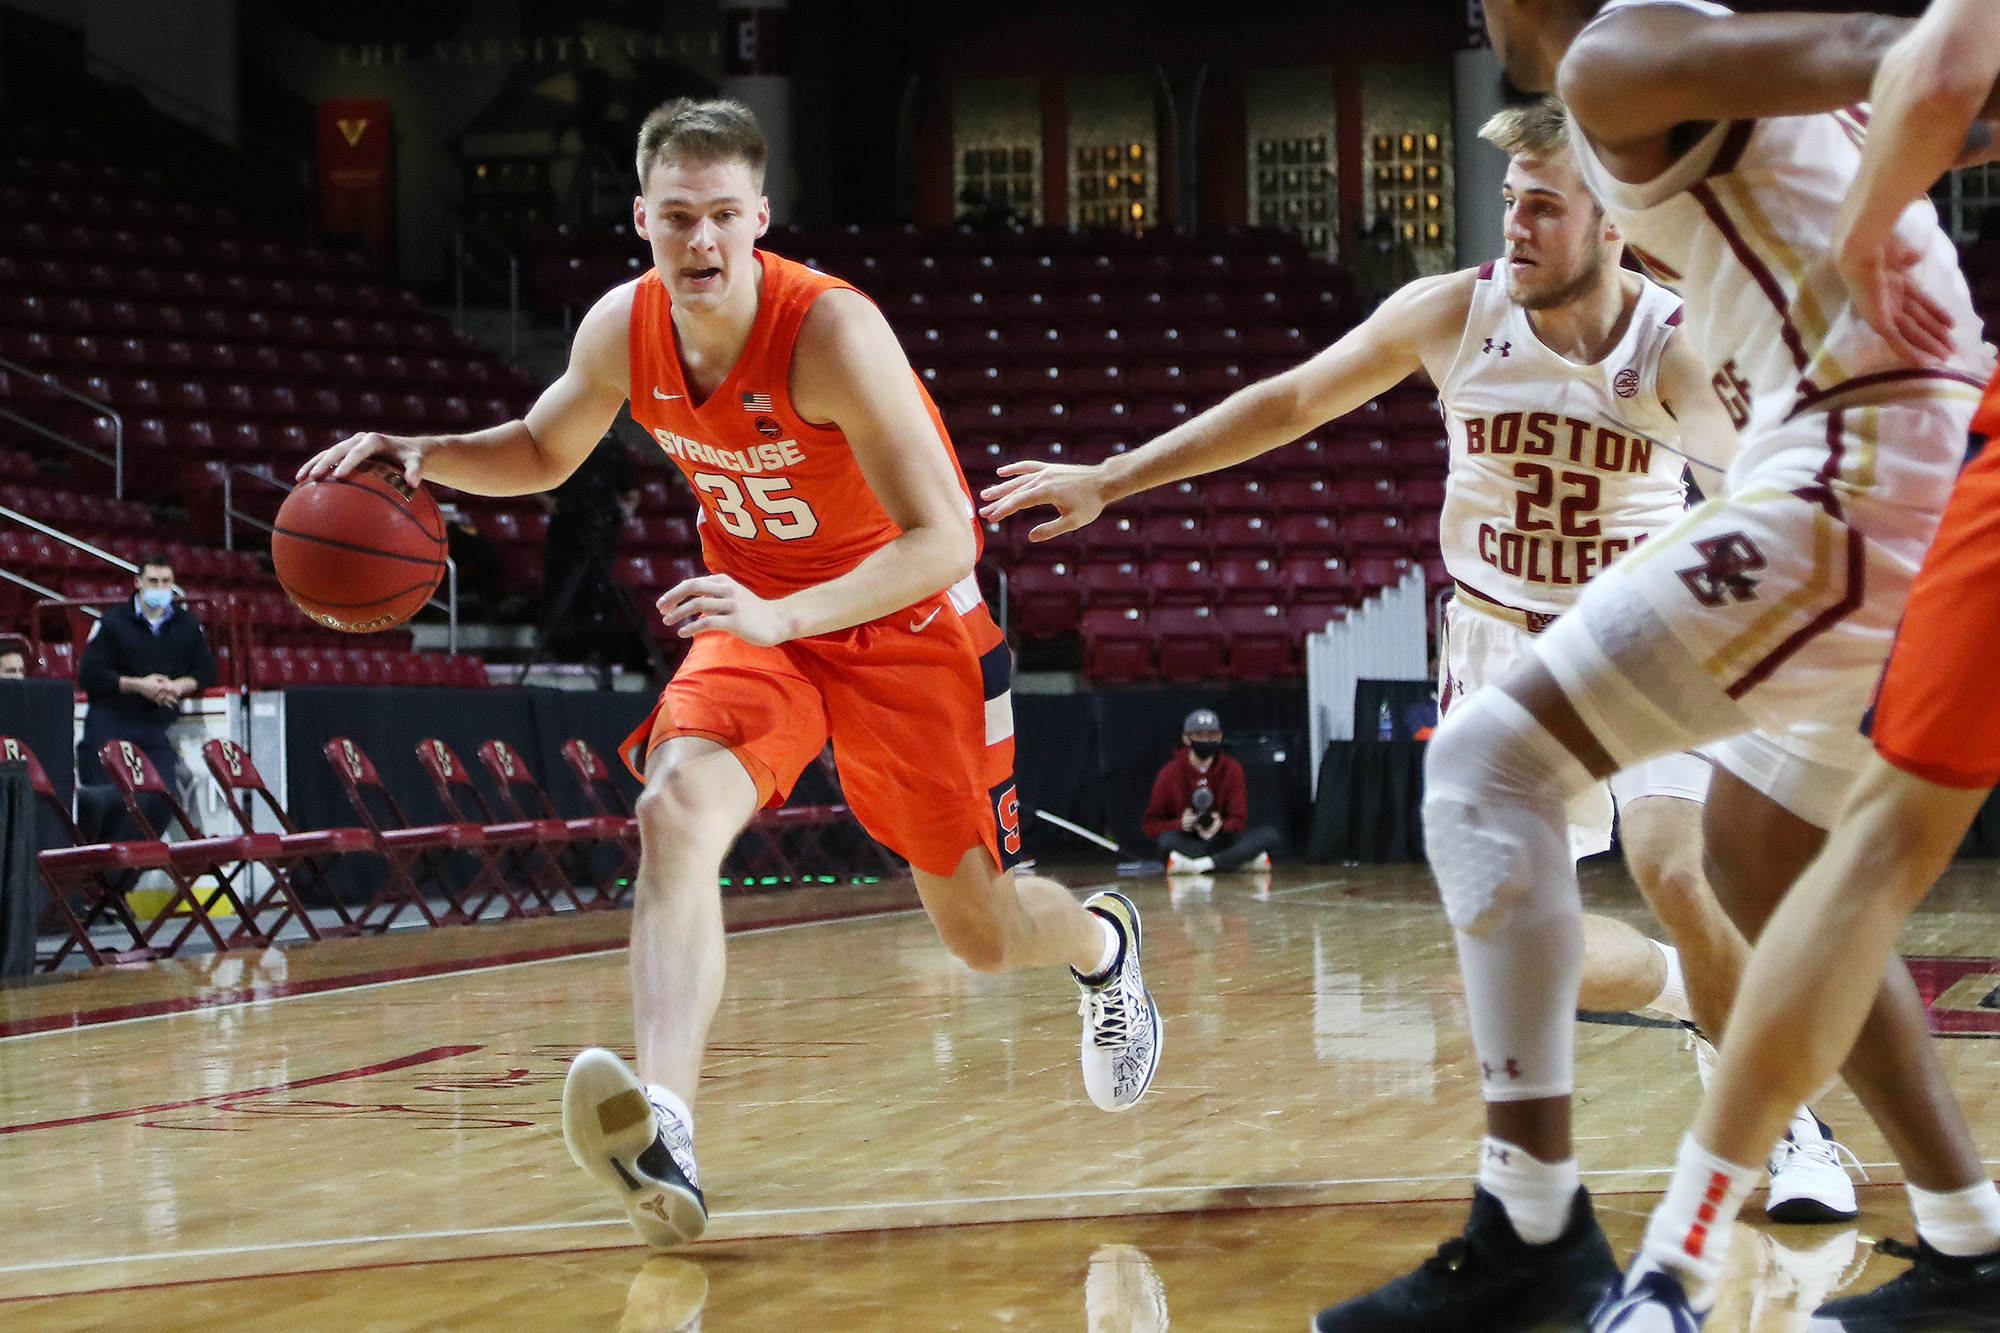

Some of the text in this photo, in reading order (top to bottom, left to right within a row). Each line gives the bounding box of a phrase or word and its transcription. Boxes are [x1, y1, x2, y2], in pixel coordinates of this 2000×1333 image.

[336, 42, 408, 67] THE
[653, 427, 806, 473] SYRACUSE
[1465, 411, 1653, 474] BOSTON
[693, 471, 819, 540] 35
[1513, 462, 1601, 537] 22
[1478, 523, 1648, 585] COLLE
